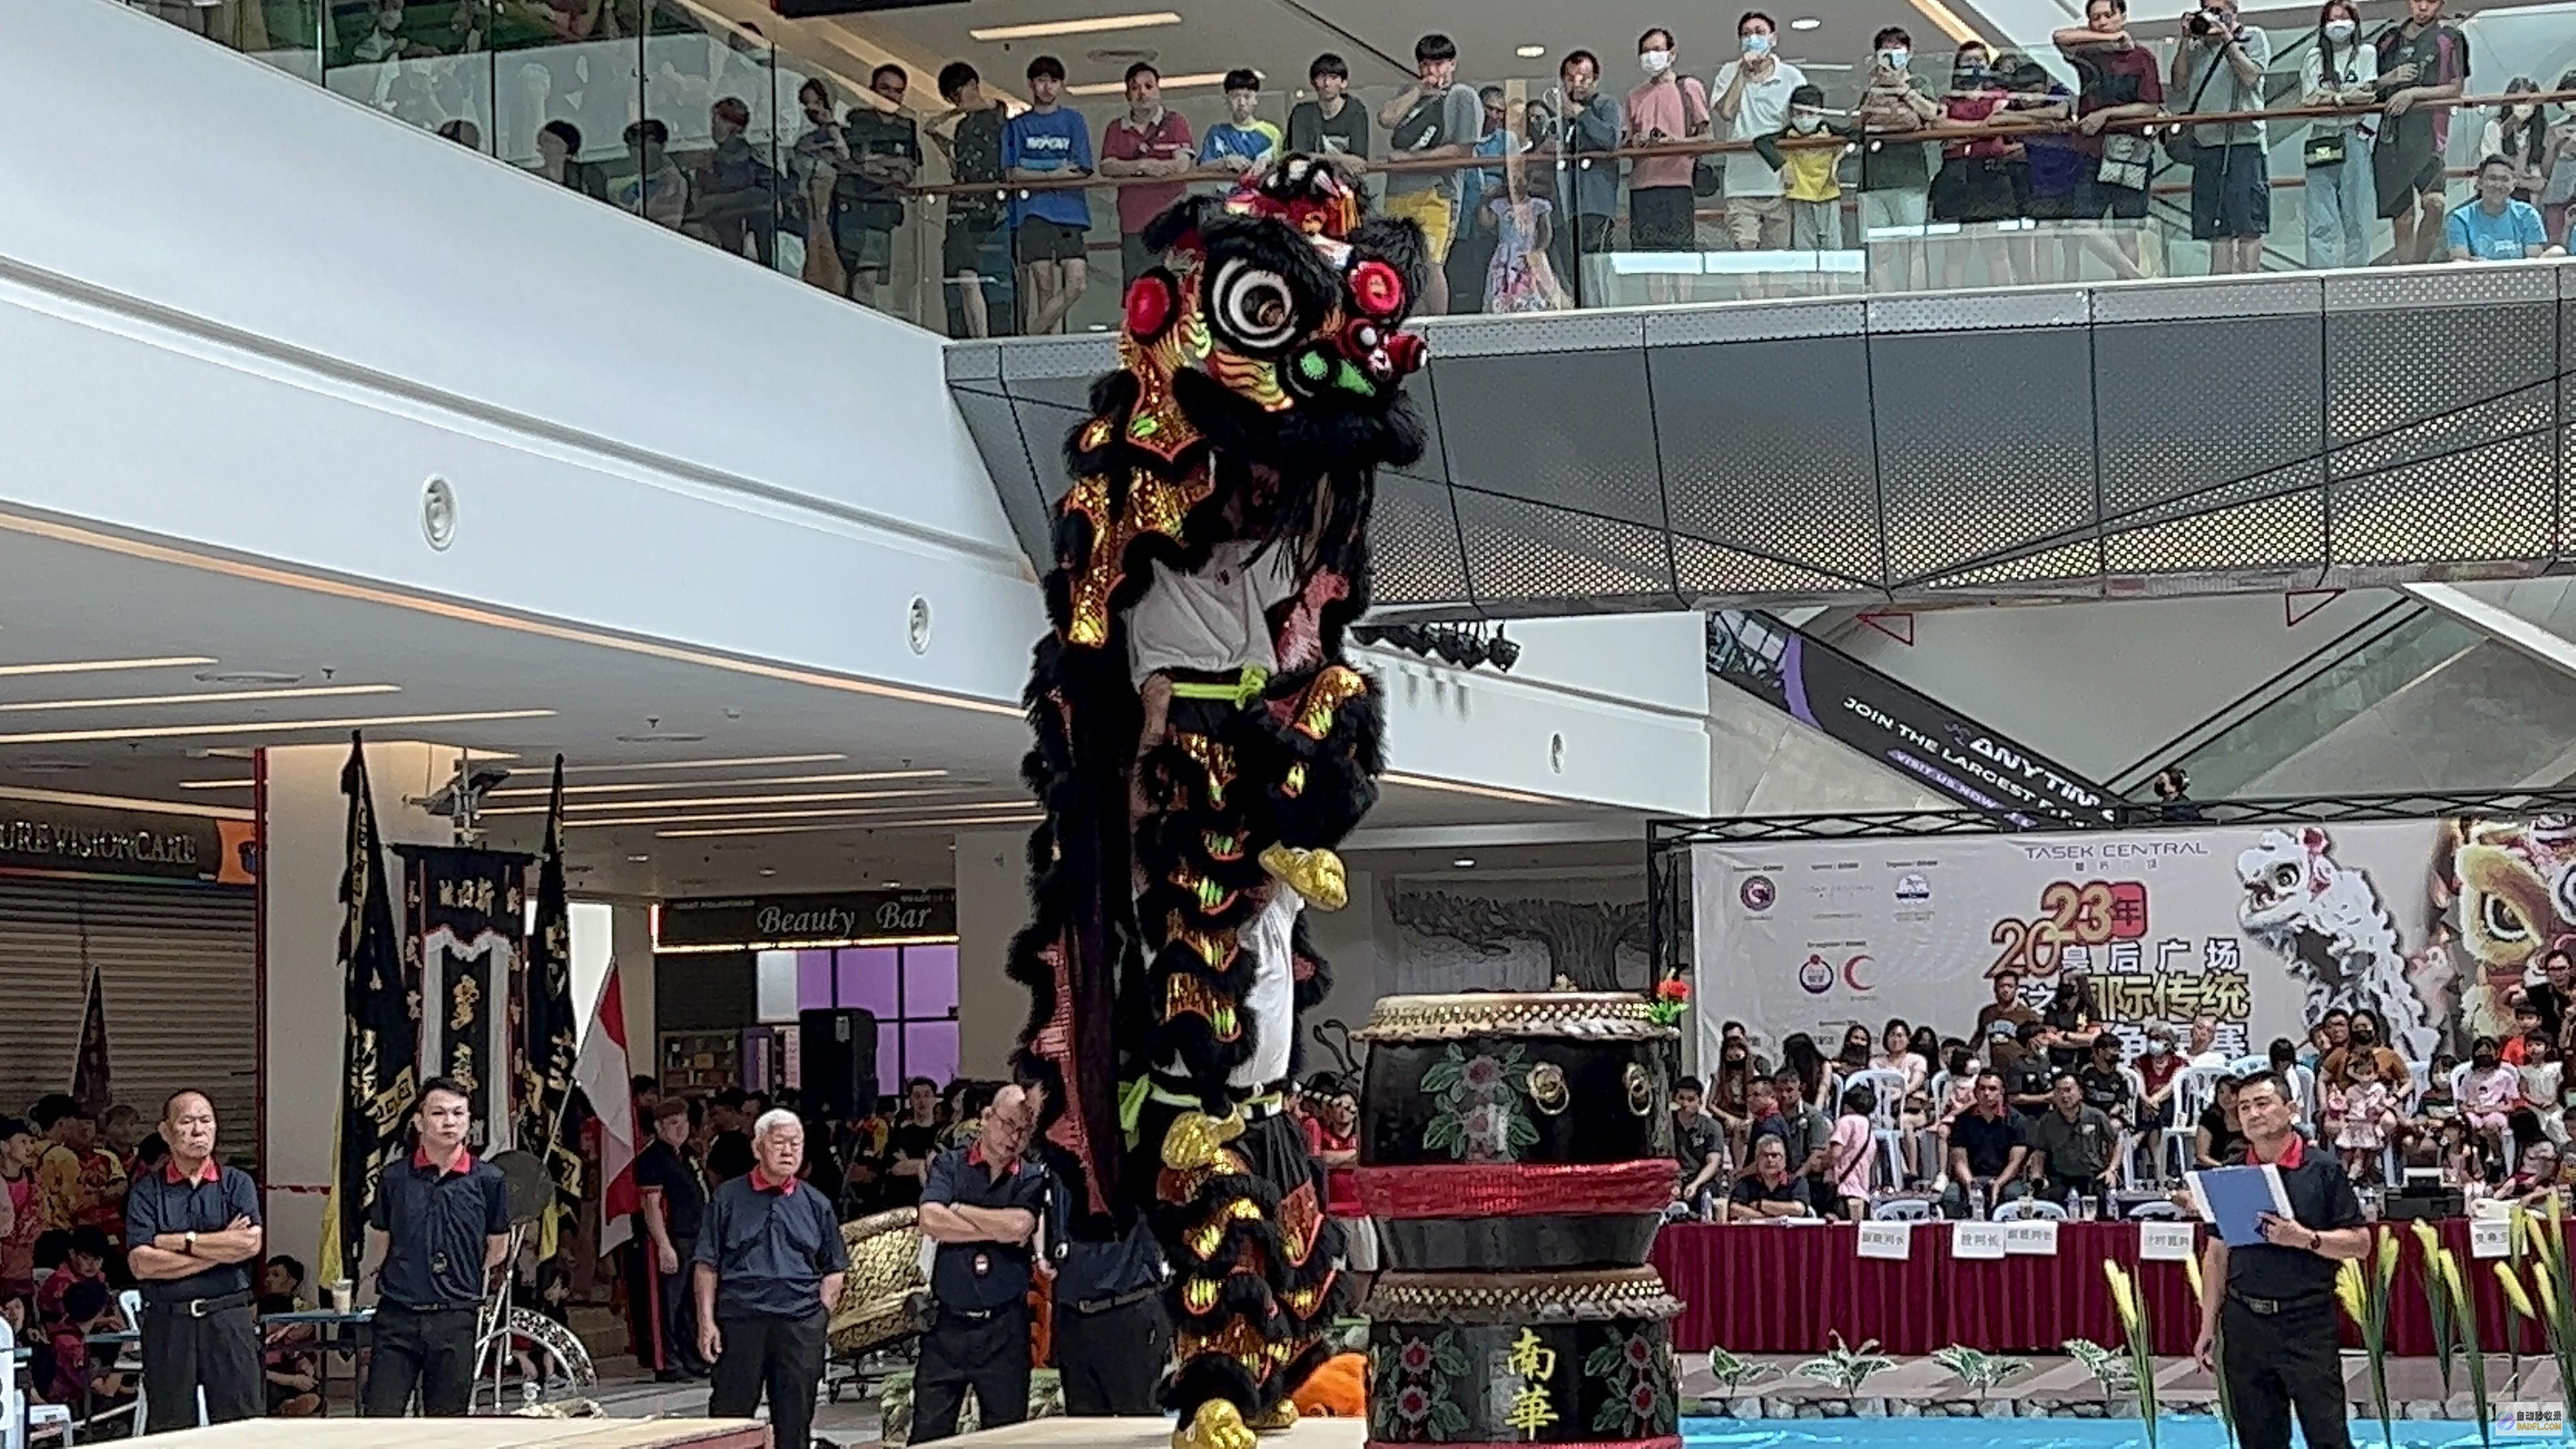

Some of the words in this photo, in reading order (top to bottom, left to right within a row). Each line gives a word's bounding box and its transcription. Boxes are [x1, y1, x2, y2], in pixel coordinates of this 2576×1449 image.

[1843, 696, 1894, 730] JOIN
[1898, 723, 1939, 753] THE
[1941, 748, 2036, 802] LARGEST
[1959, 784, 1997, 808] NOW
[2025, 845, 2094, 859] TASEK
[2102, 842, 2208, 858] CENTRAL
[756, 905, 856, 939] Beauty
[875, 901, 932, 929] Bar
[1505, 1326, 1559, 1441] 南華
